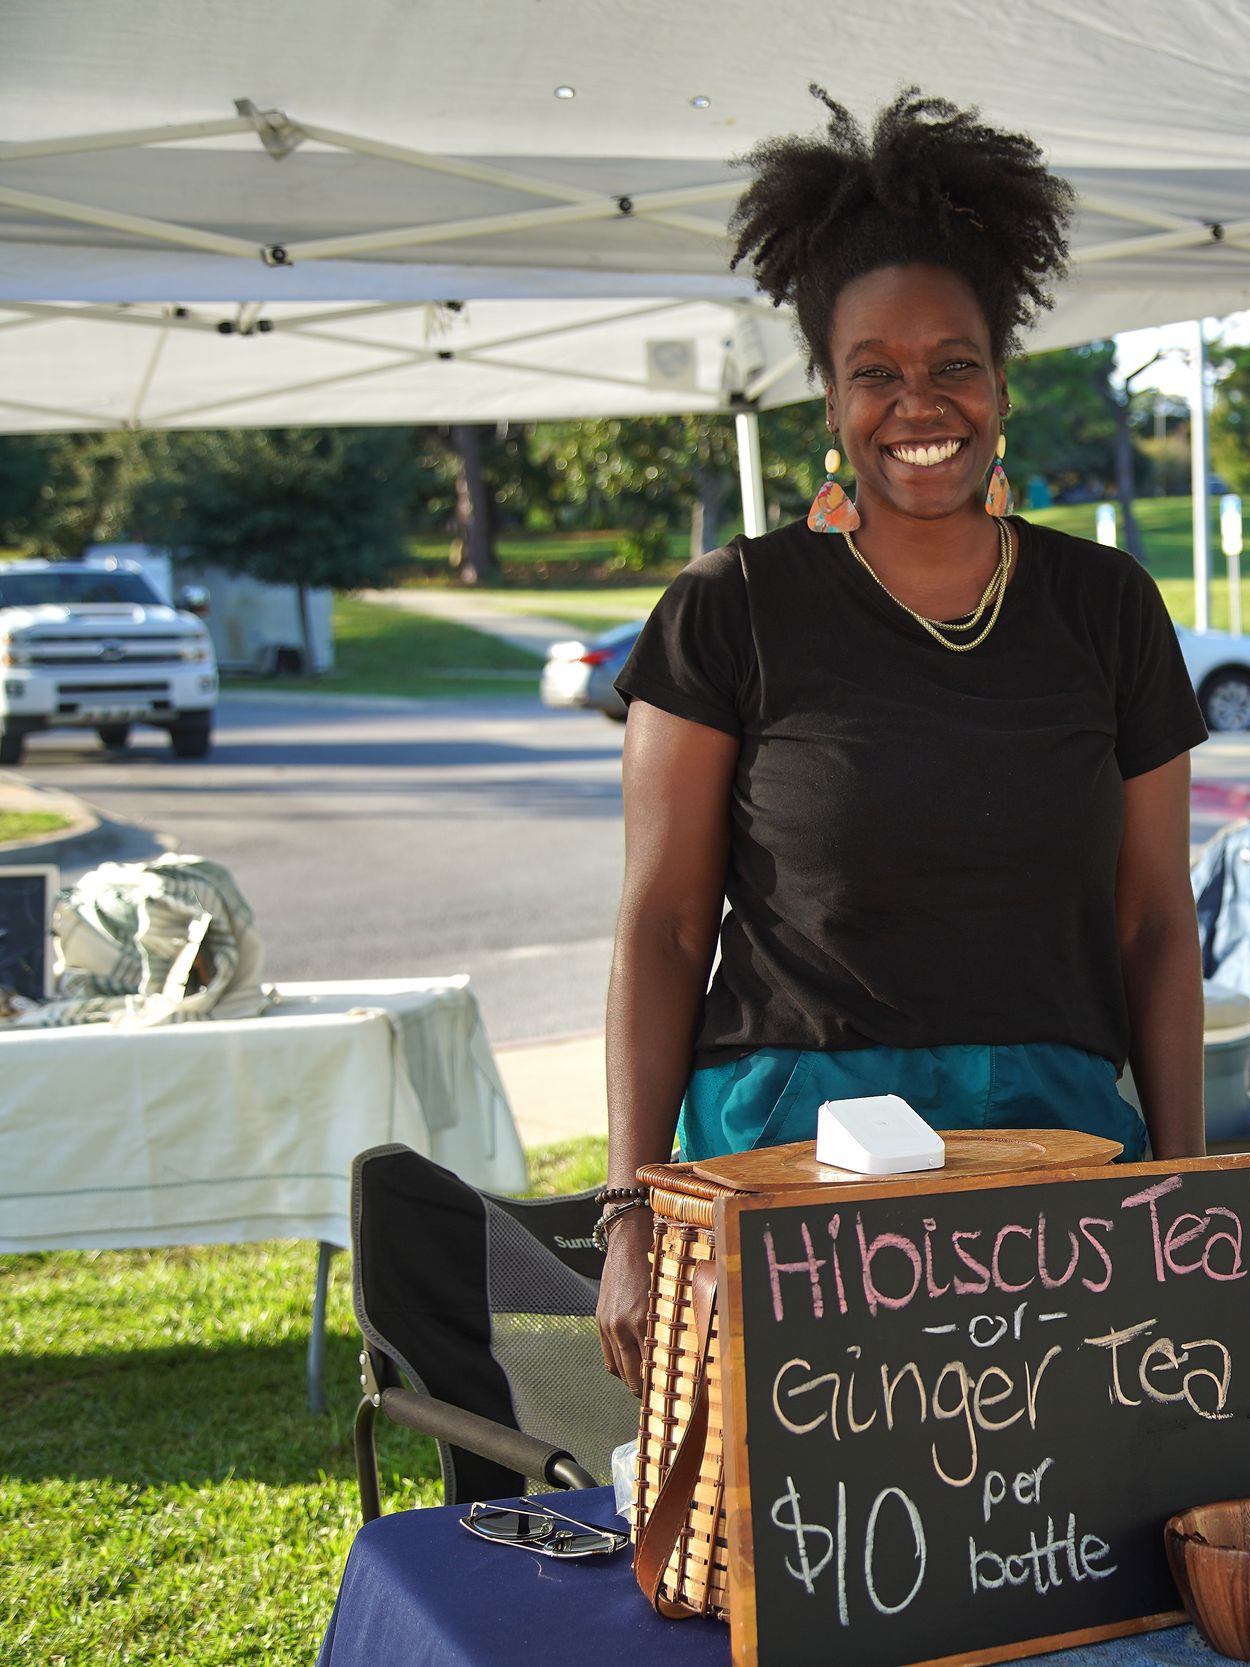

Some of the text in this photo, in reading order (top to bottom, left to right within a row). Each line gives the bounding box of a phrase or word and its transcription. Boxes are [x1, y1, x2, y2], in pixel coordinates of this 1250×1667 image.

[762, 1174, 1249, 1321] Hibiscus Tea
[773, 1318, 1234, 1487] Ginger Tea
[770, 1476, 926, 1626] $10
[968, 1512, 1117, 1596] bottle
[983, 1457, 1054, 1522] per
